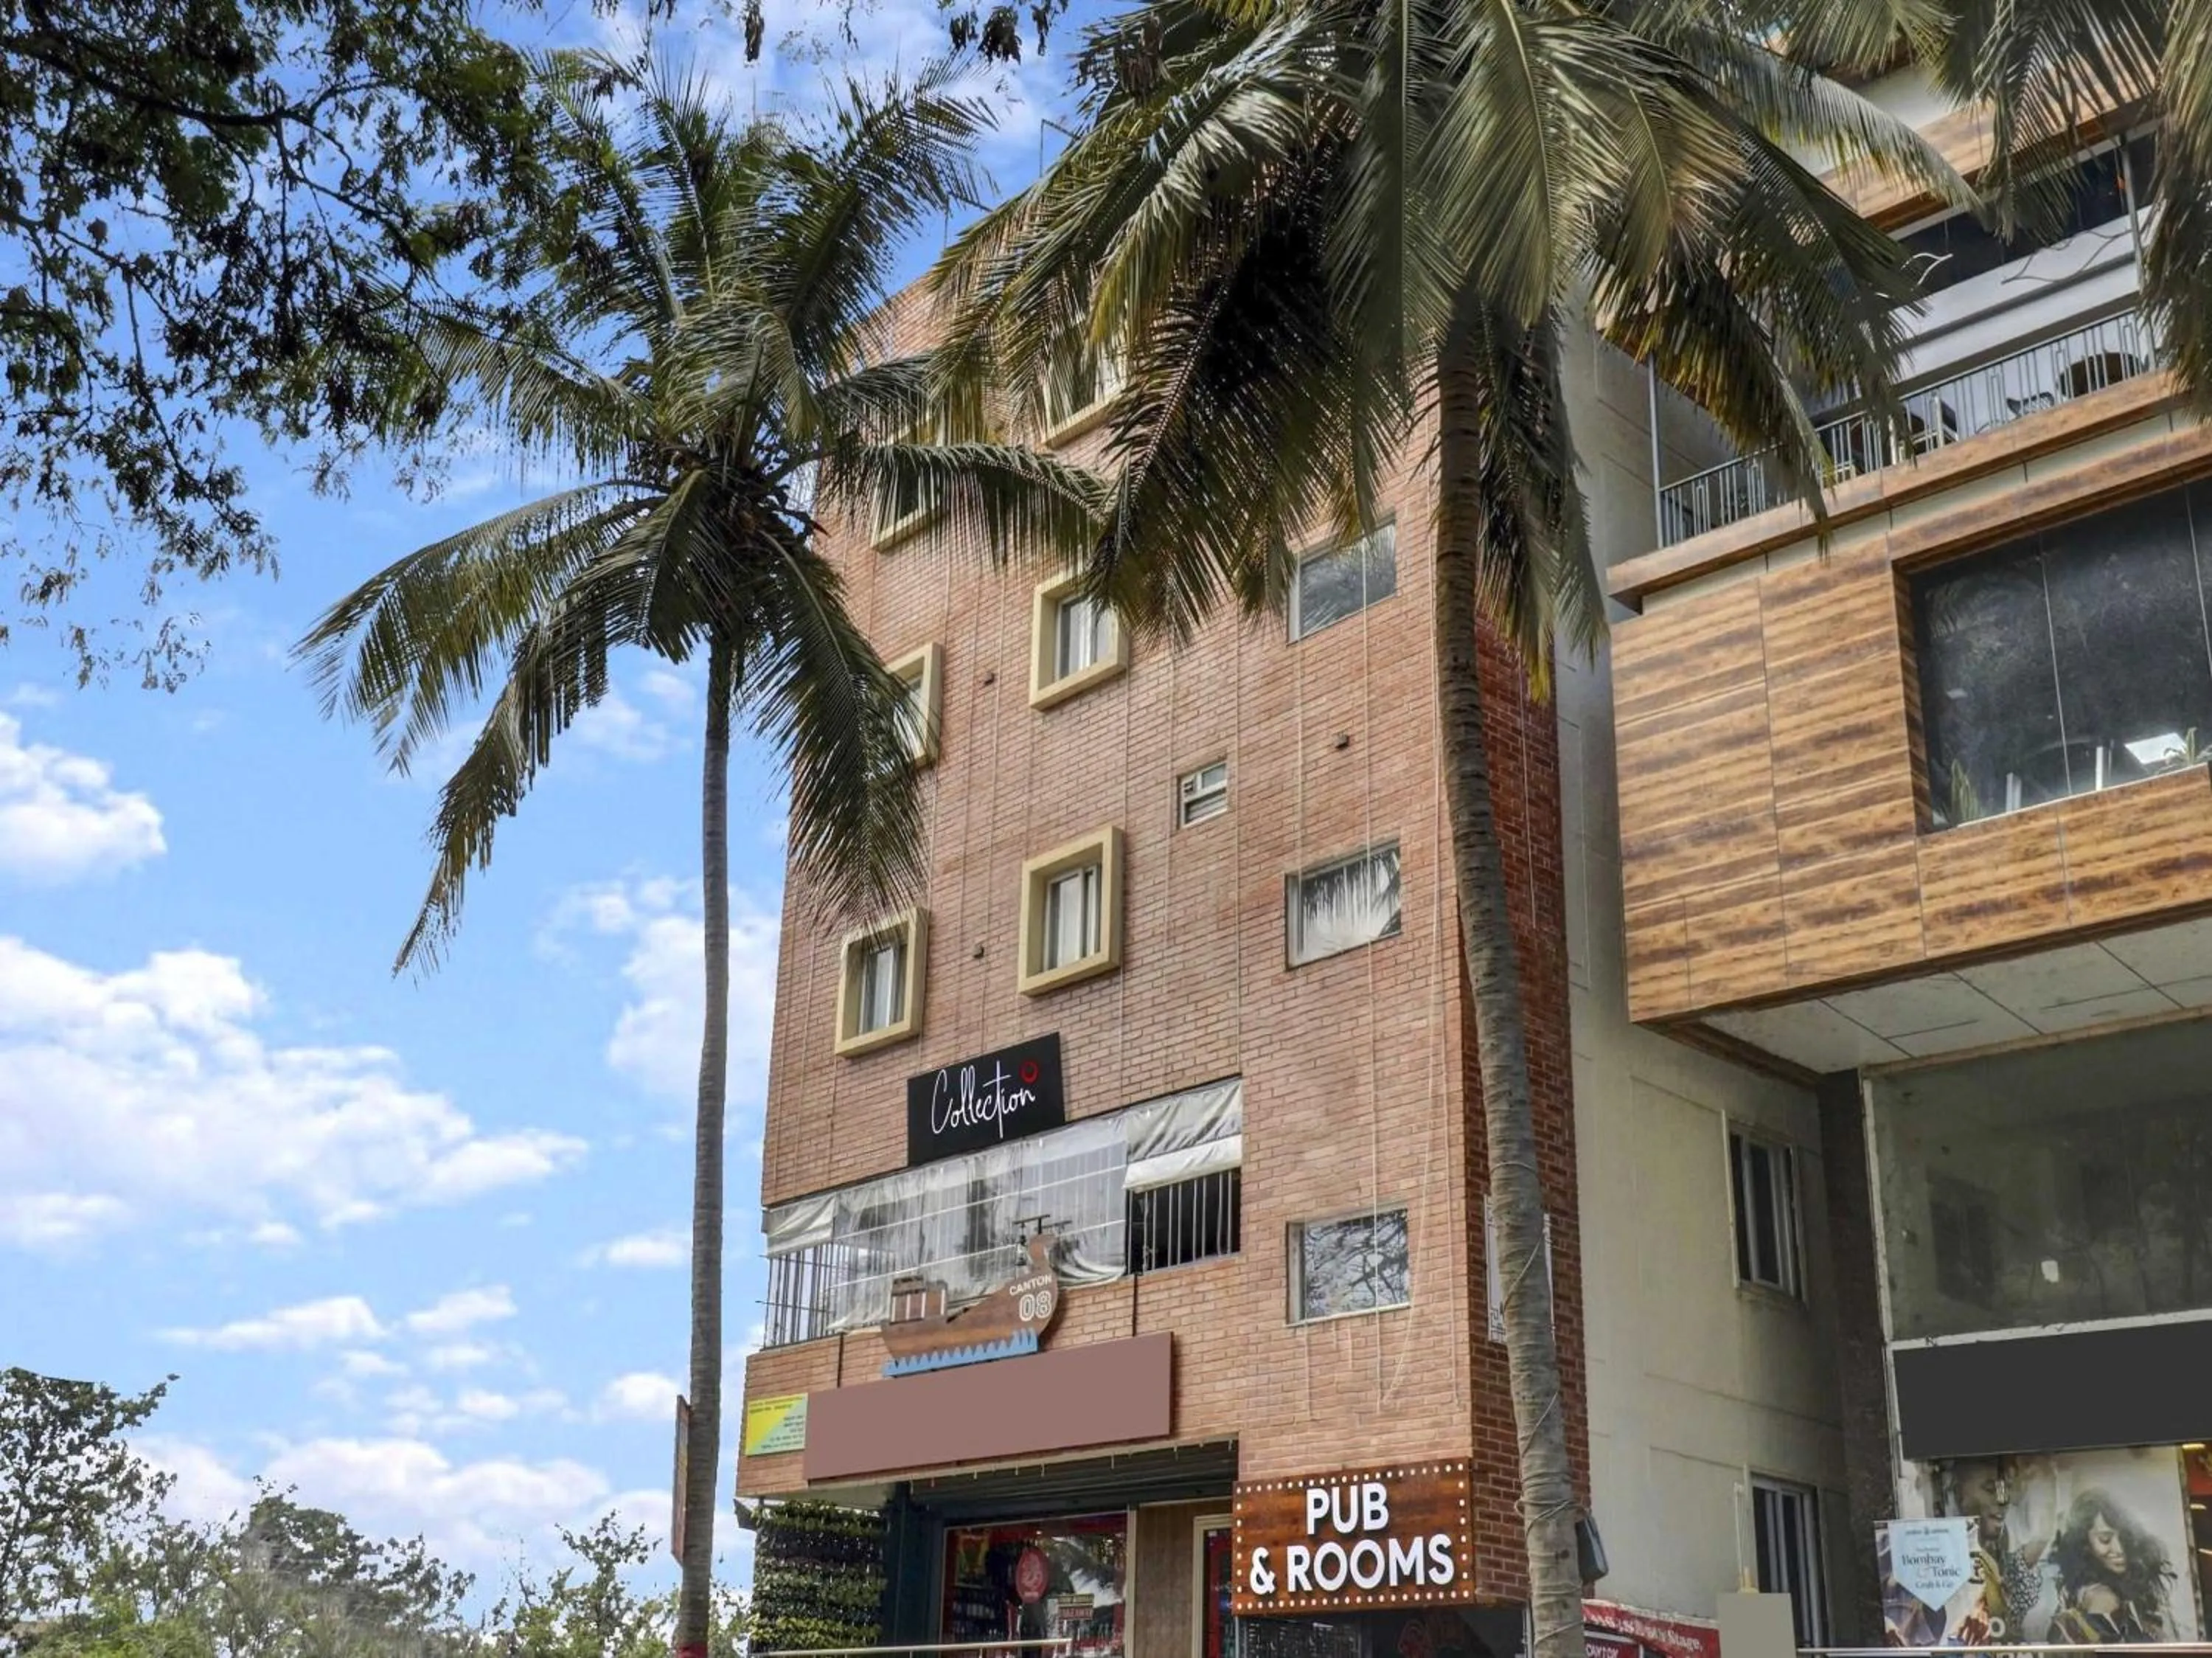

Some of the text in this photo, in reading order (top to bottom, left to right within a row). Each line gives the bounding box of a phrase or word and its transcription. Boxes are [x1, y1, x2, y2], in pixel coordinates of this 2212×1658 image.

[931, 1060, 1036, 1139] Collection
[1009, 1274, 1052, 1297] CANTON
[1019, 1289, 1052, 1322] 08
[1306, 1482, 1389, 1535] PUB
[1249, 1533, 1455, 1595] & ROOMS
